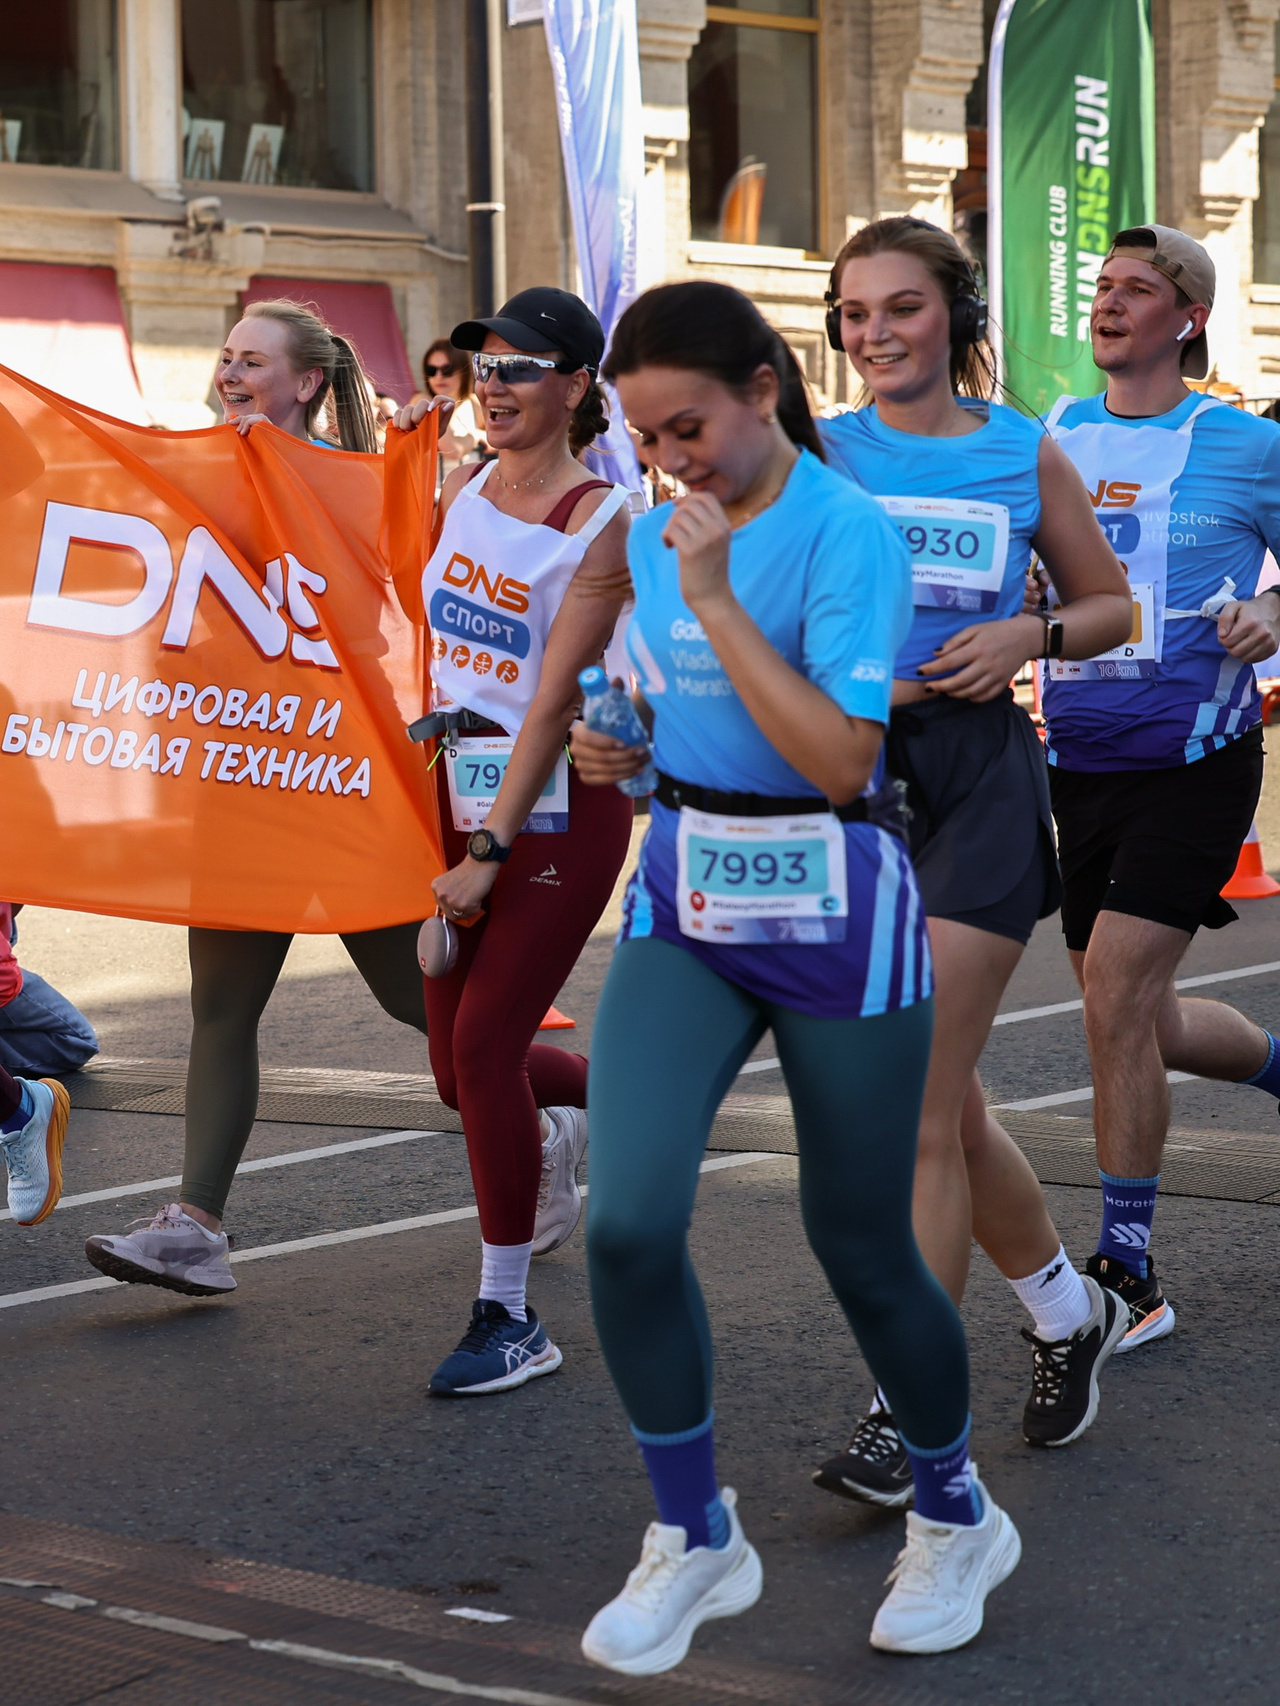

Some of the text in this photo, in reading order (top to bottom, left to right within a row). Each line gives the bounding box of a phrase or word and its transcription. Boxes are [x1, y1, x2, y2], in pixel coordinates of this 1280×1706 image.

[1049, 184, 1068, 338] RUNNING CLUB
[1087, 480, 1142, 507] NS
[899, 526, 979, 559] 930
[27, 500, 342, 670] DNS
[442, 552, 531, 614] DNS
[442, 602, 514, 644] СПОРТ
[1125, 647, 1135, 657] D
[1098, 663, 1140, 677] 10km
[71, 668, 342, 739] ЦИФРОВАЯ И
[1, 713, 372, 798] БЫТОВАЯ ТЕХНИКА
[450, 749, 458, 758] D
[466, 763, 508, 789] 79
[529, 876, 562, 887] DEMIX
[700, 848, 808, 886] 7993
